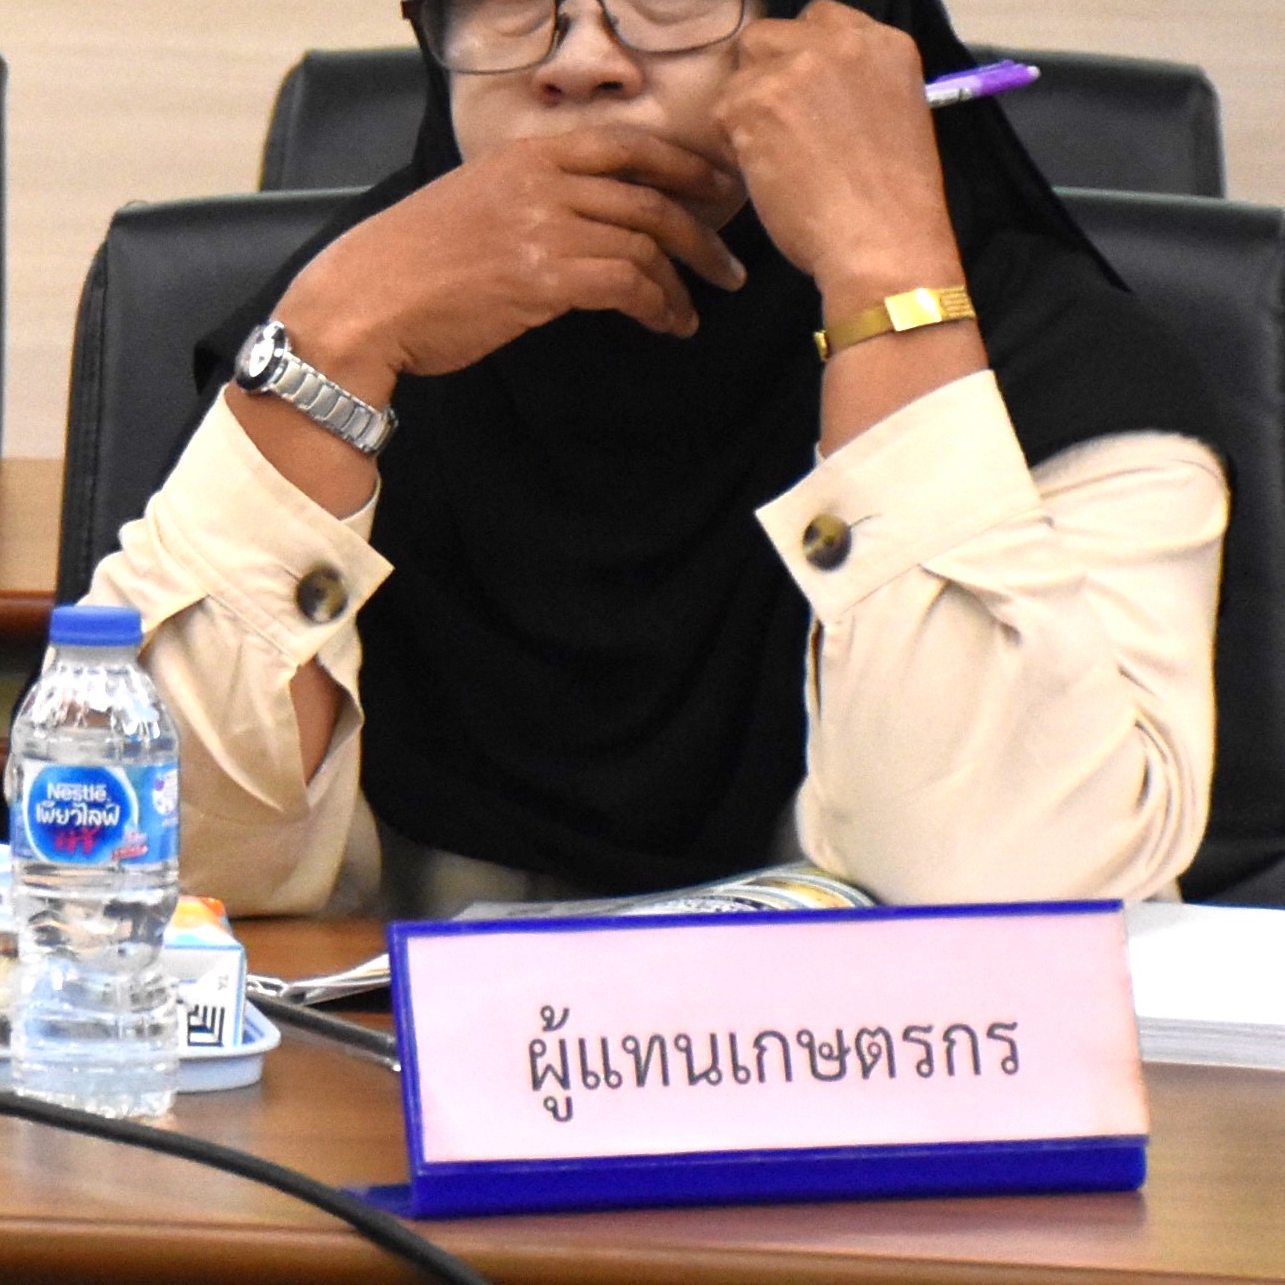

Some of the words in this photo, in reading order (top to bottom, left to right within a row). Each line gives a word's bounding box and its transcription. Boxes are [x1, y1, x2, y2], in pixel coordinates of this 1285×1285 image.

[528, 1004, 1019, 1123] ผู้แทนเกษตรกร
